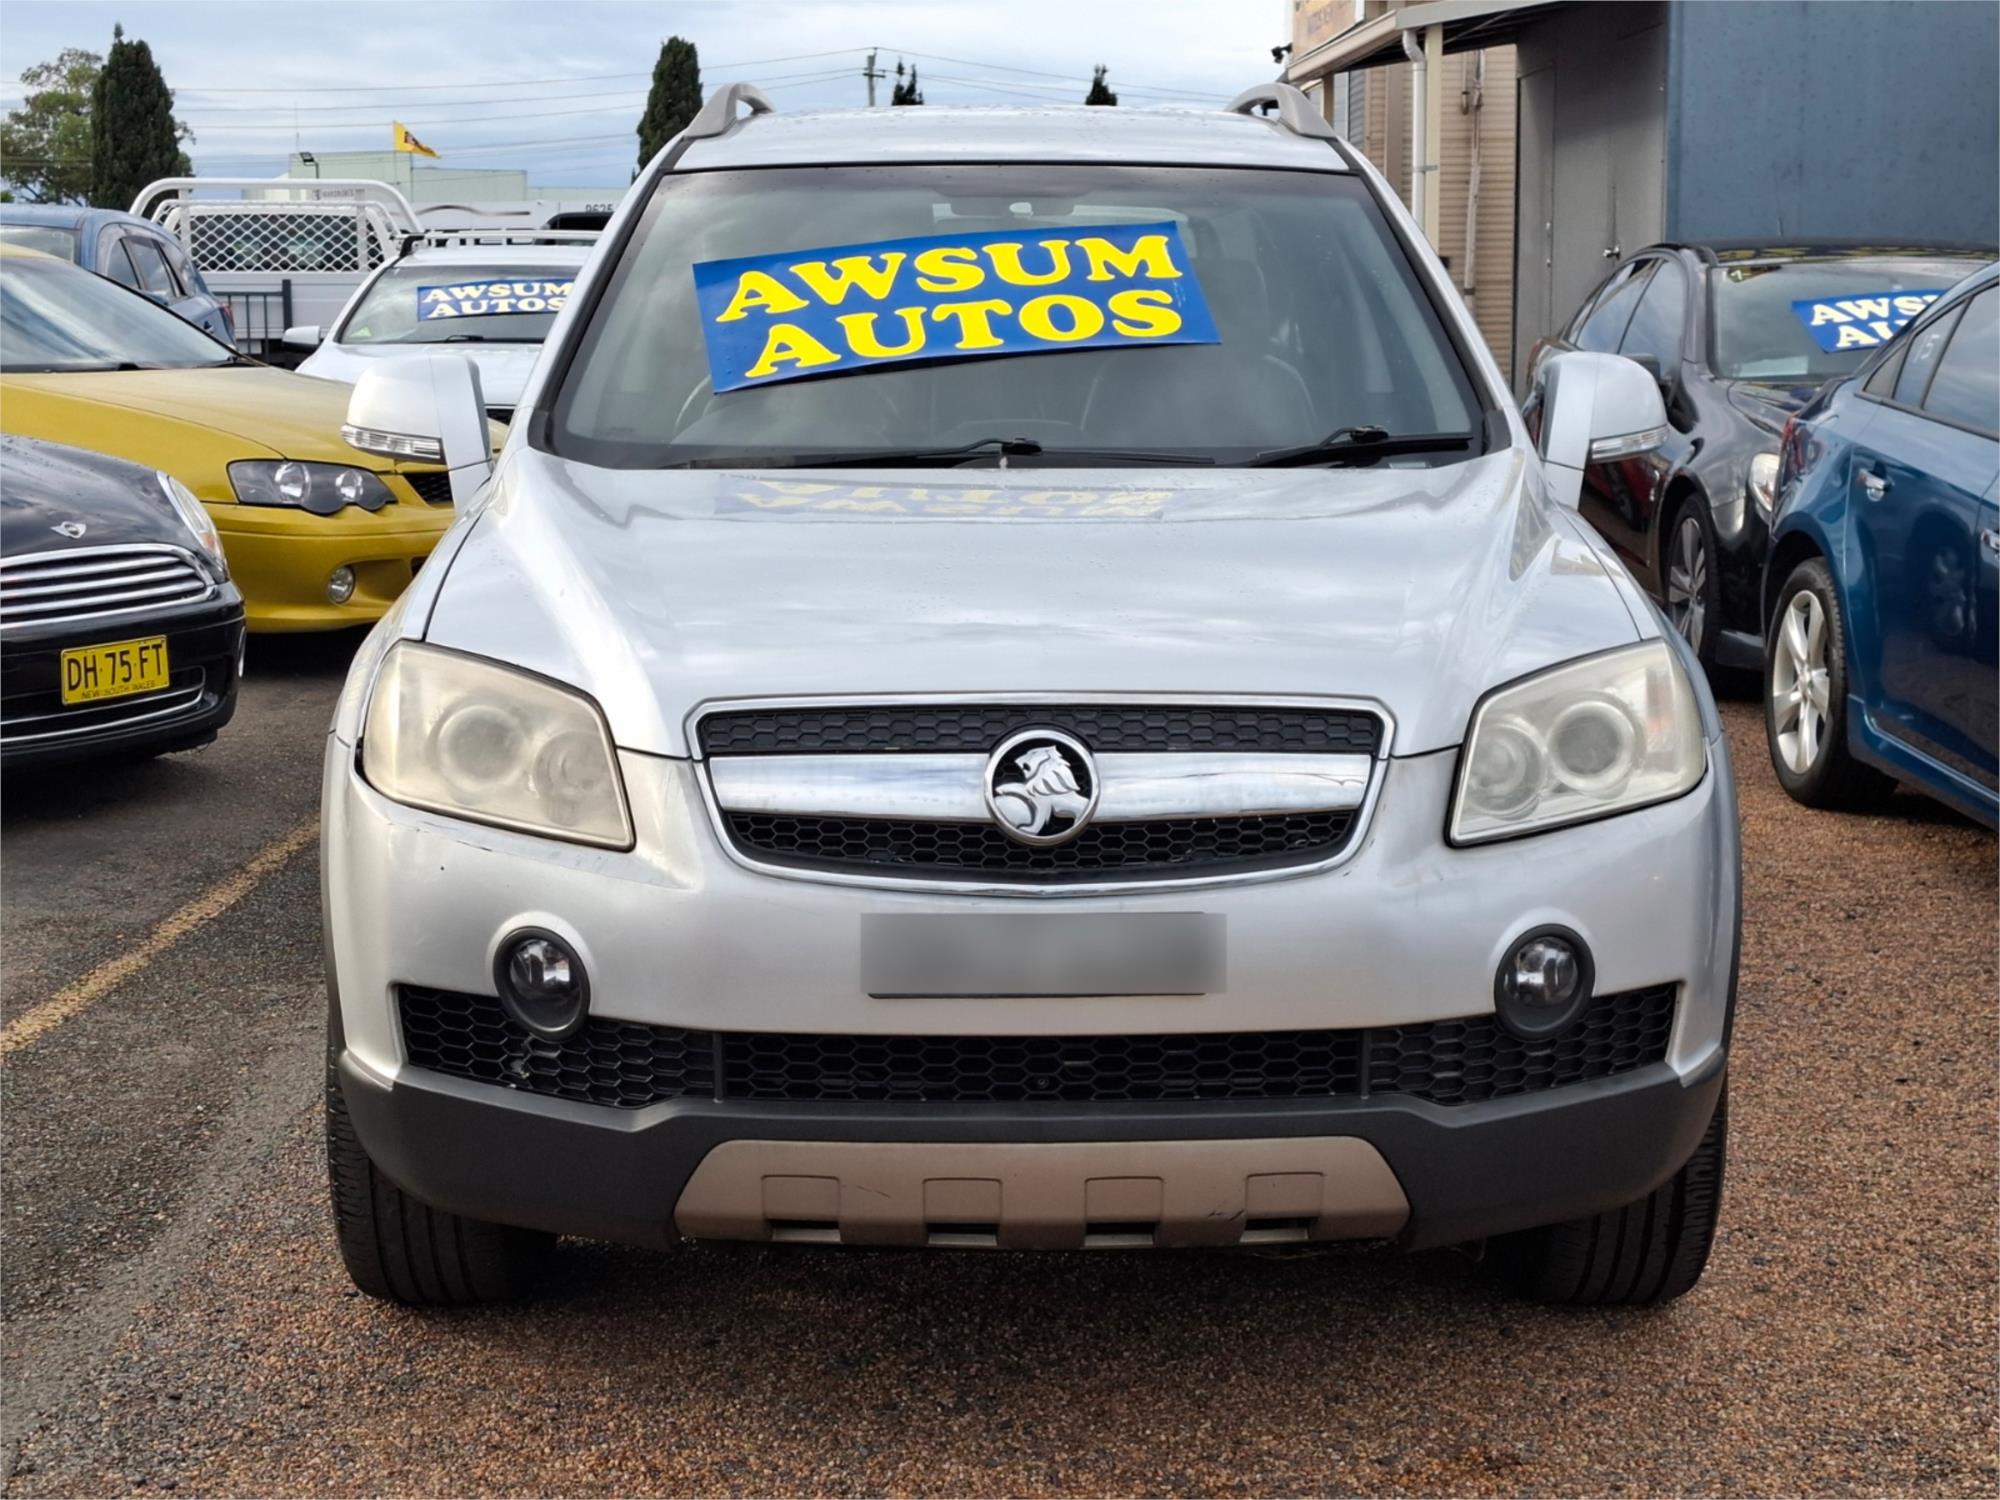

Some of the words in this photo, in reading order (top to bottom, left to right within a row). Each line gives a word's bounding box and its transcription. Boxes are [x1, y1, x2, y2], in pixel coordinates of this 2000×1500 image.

[422, 282, 573, 303] AWSUM
[715, 234, 1183, 323] AWSUM
[427, 297, 566, 318] AUTOS
[1810, 295, 1940, 327] AWS
[745, 289, 1183, 378] AUTOS
